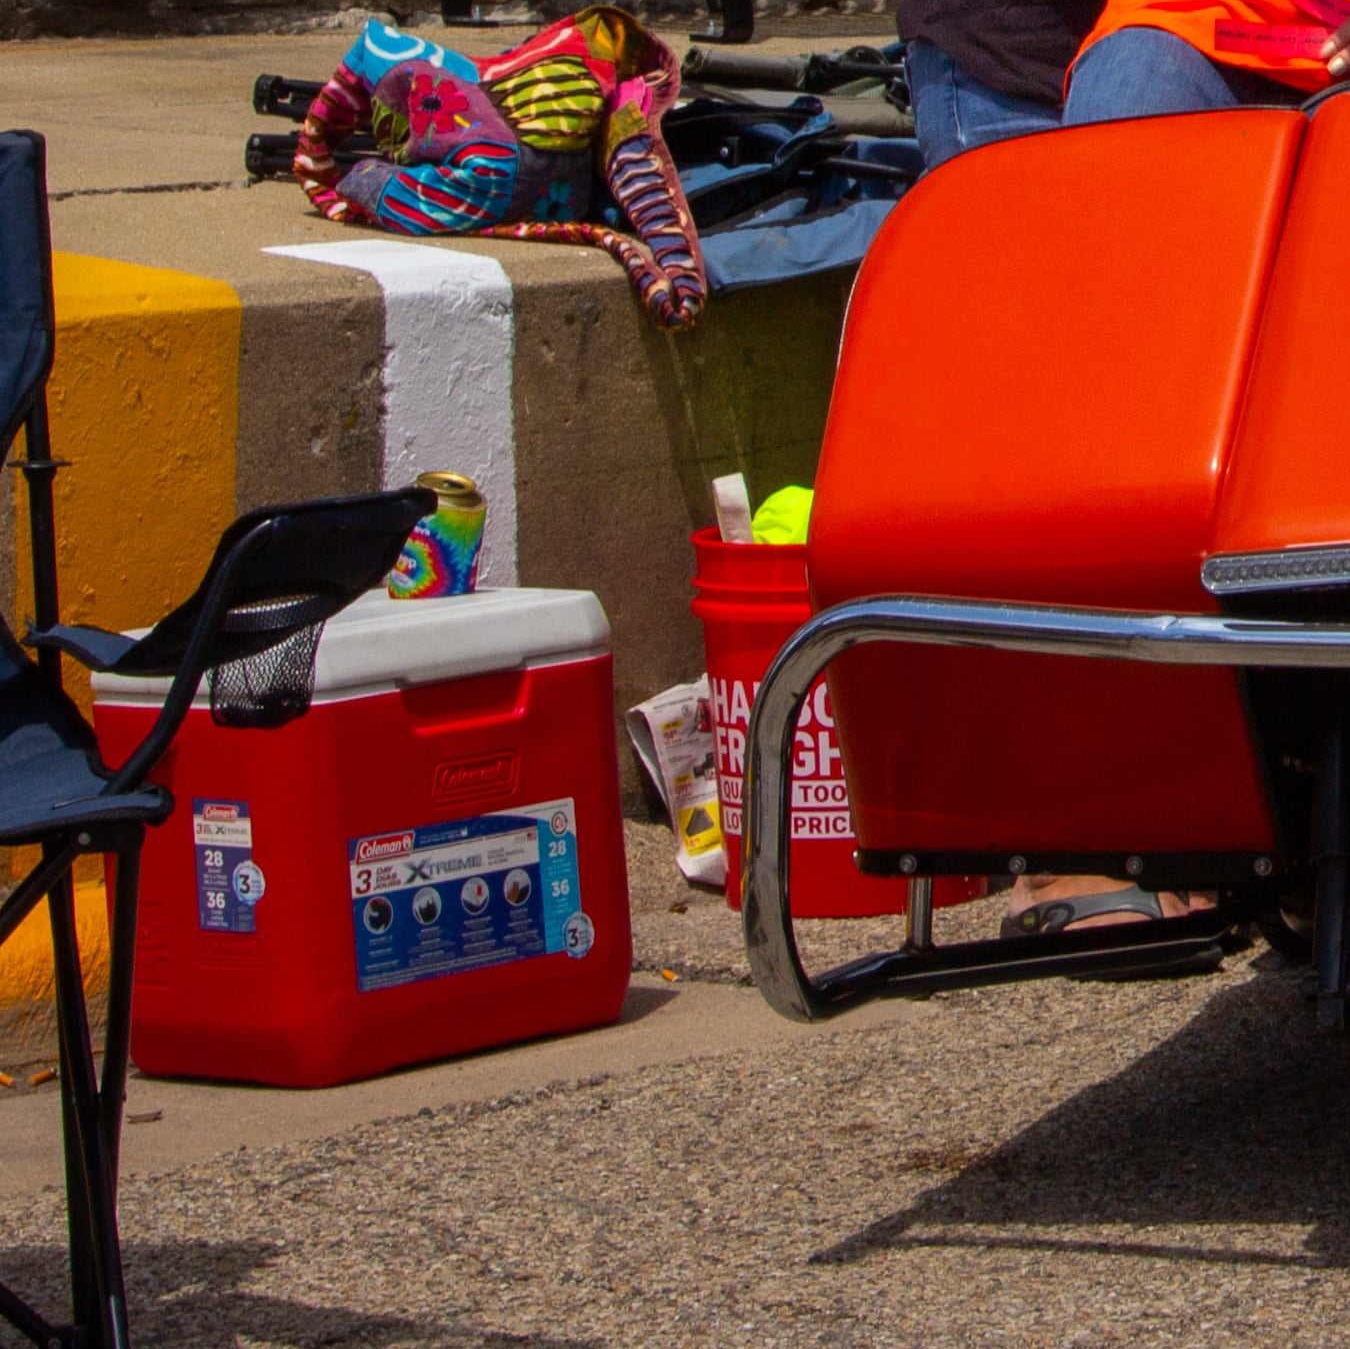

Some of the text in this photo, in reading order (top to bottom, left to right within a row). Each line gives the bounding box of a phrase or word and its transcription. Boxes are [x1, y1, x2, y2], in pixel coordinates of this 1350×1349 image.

[712, 677, 836, 729] HABO
[716, 726, 845, 778] FRGH
[204, 849, 224, 867] 28
[359, 838, 402, 860] Coleman
[548, 840, 567, 858] 28
[238, 874, 251, 894] 3
[355, 869, 373, 895] 3
[404, 855, 482, 884] XTREME
[550, 879, 570, 898] 36
[206, 892, 226, 909] 36
[568, 928, 580, 948] 3
